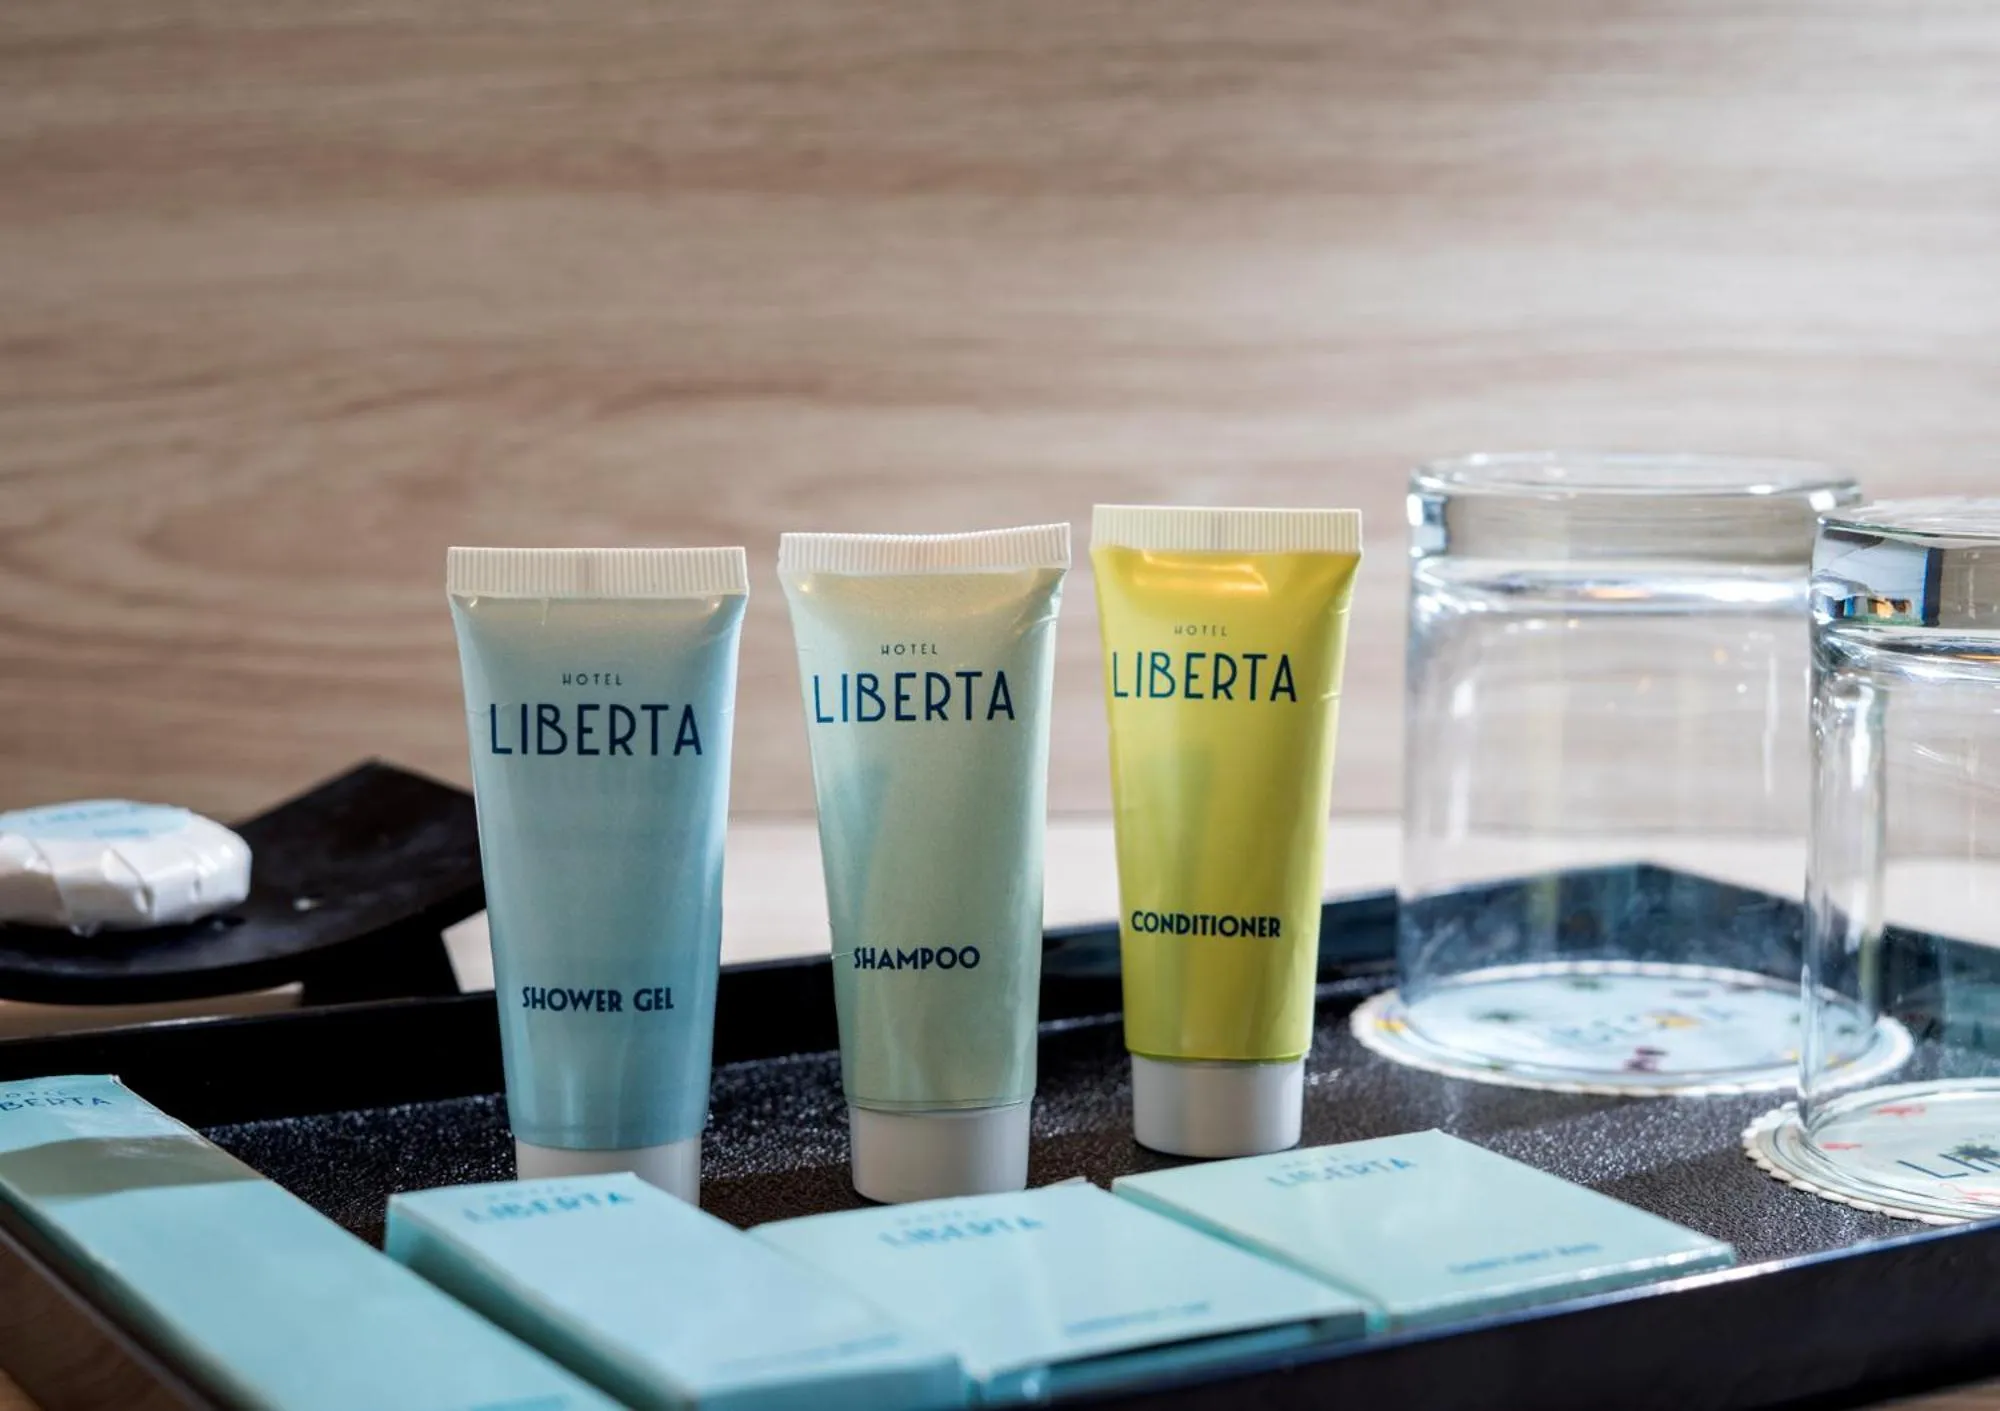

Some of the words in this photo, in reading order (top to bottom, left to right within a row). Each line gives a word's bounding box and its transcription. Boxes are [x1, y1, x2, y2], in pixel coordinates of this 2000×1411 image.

[1173, 623, 1229, 638] HOTEL
[880, 642, 939, 657] HOTEL
[561, 672, 624, 688] HOTEL
[1113, 651, 1297, 703] LIBERTA
[813, 670, 1015, 724] LIBERTA
[489, 703, 703, 757] LIBERTA
[1130, 909, 1282, 939] CONDITIONER
[853, 945, 981, 971] SHAMPOO
[521, 985, 624, 1013] SHOWER
[633, 985, 676, 1013] GEL
